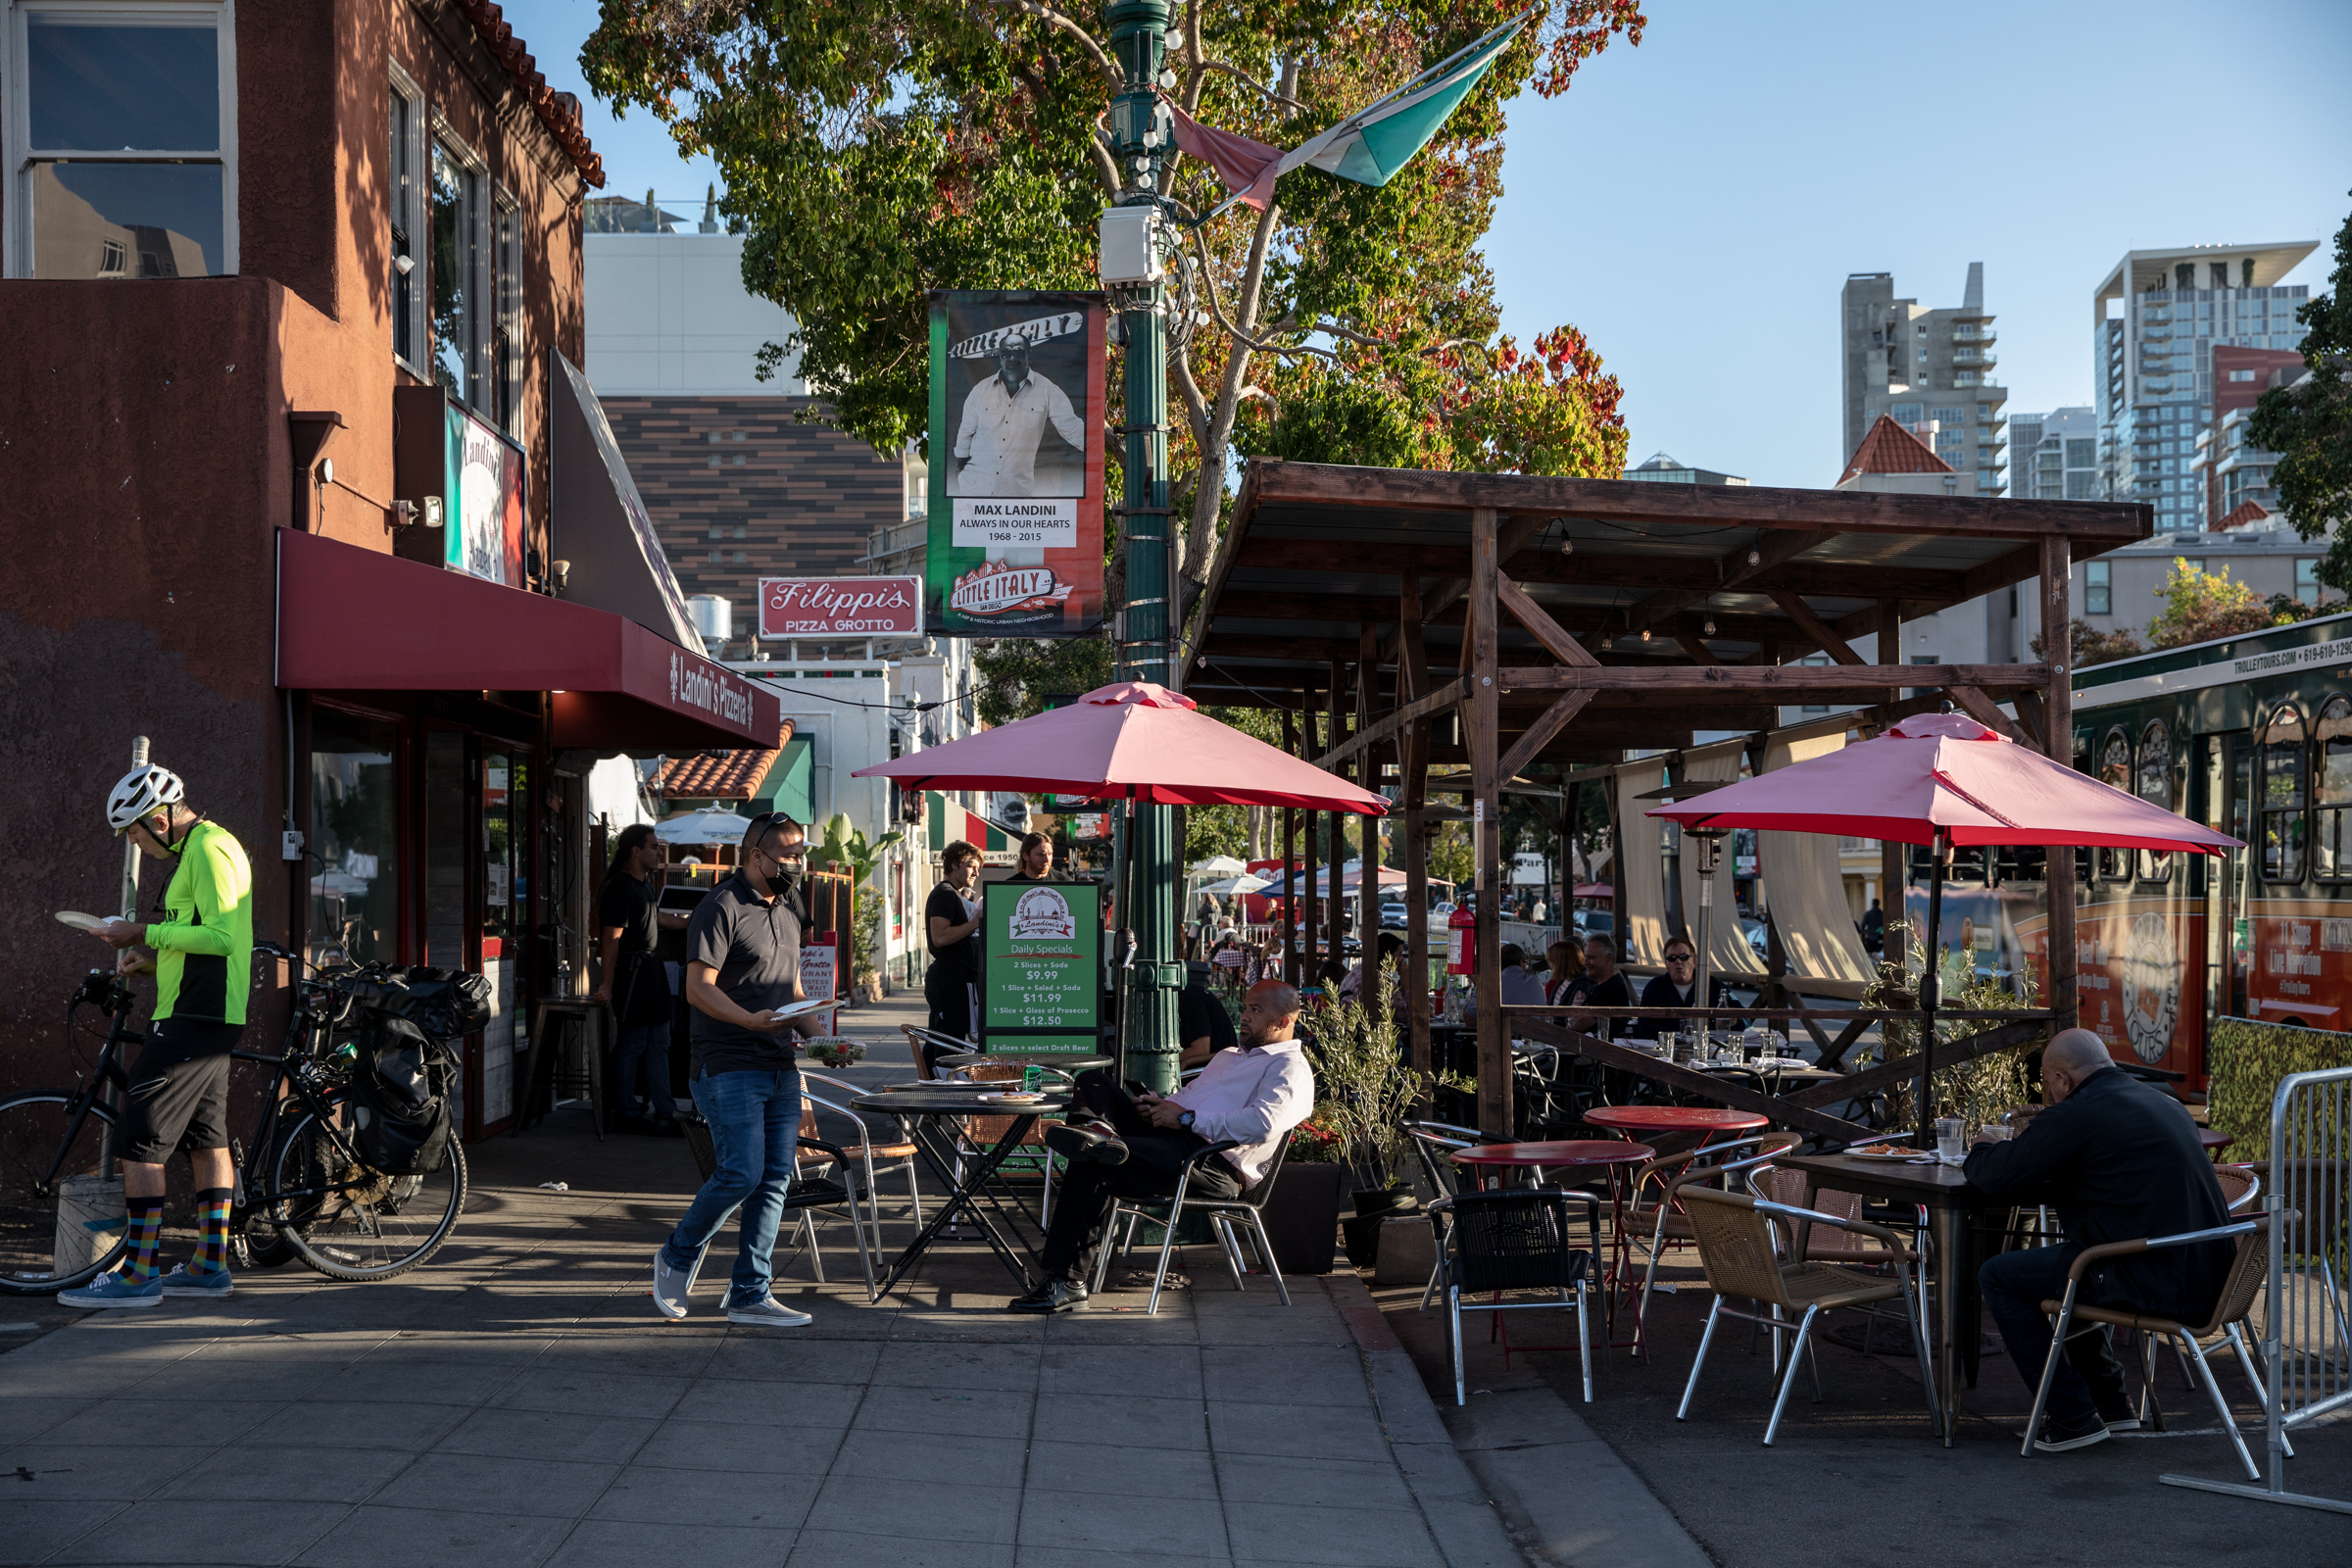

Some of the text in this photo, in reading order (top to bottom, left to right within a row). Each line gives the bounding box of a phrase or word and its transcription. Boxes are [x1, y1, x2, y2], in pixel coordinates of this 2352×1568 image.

[464, 436, 502, 490] Landini's
[974, 505, 1056, 515] MAX LANDINI
[959, 519, 1070, 528] ALWAYS IN OUR HEARTS
[989, 532, 1011, 541] 1968
[1019, 532, 1042, 541] 2015
[956, 572, 1040, 606] LITTLE ITALY
[770, 583, 911, 617] Filippi's
[1013, 612, 1054, 623] NEIGHBORHOOD
[786, 619, 894, 632] PIZZA GROTTO
[2234, 652, 2296, 674] TROLLEYTOURS.COM
[680, 656, 747, 726] Landini's Pizzeria
[800, 948, 824, 957] ppi's
[1011, 945, 1073, 955] Daily Specials
[802, 959, 831, 970] Grotto
[2269, 948, 2322, 976] Live Narration
[1026, 970, 1058, 980] $9.99
[1023, 993, 1061, 1003] $11.99
[1023, 1015, 1061, 1026] $12.50
